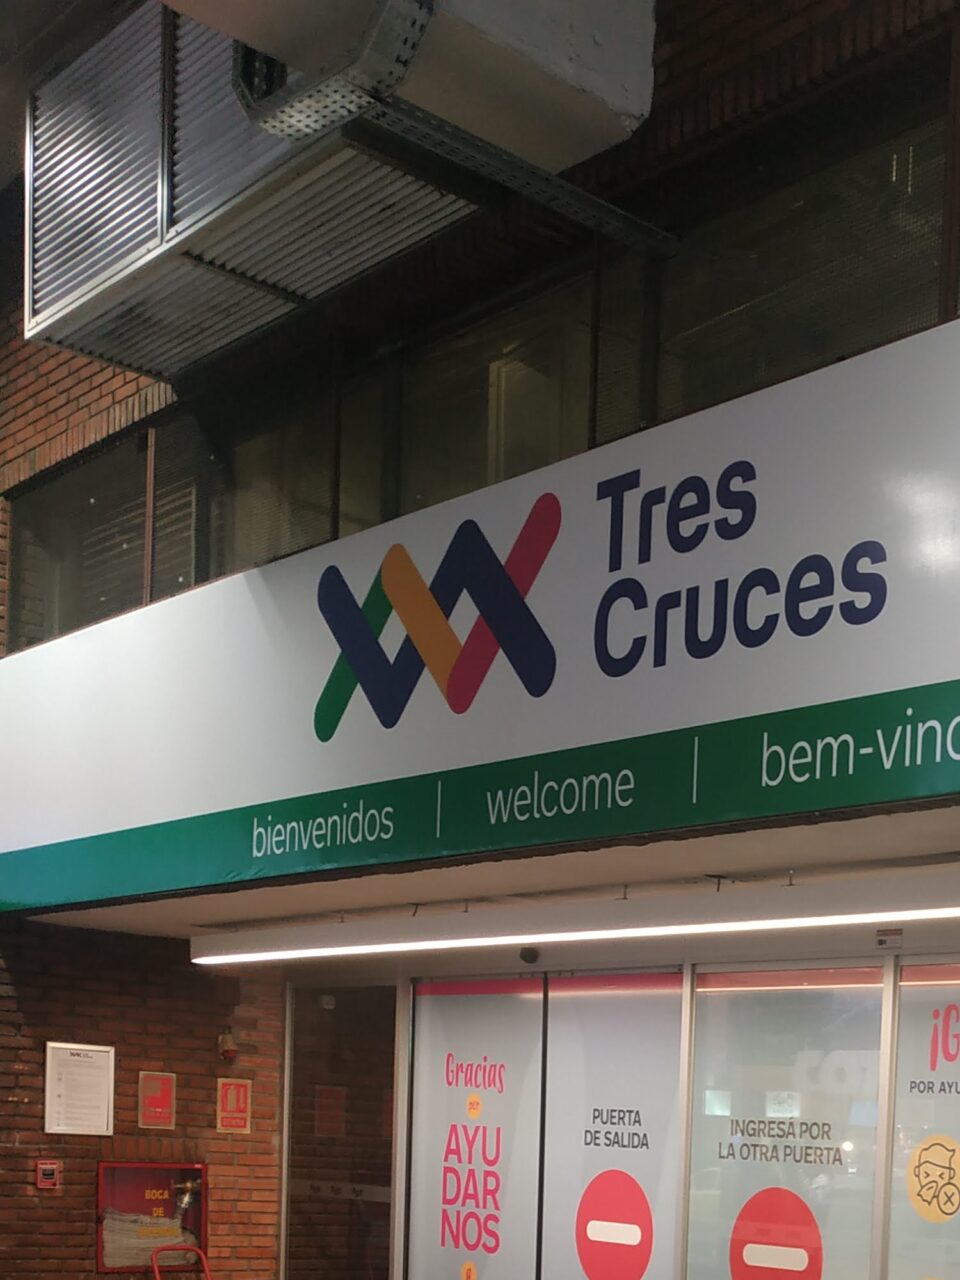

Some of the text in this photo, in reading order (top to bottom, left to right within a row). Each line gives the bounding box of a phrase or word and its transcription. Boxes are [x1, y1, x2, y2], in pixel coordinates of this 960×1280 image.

[596, 459, 757, 573] Tres
[594, 539, 889, 678] Cruces
[486, 762, 636, 825] welcome
[252, 801, 395, 858] bienvenidos
[445, 1053, 505, 1094] Gracias
[909, 1080, 934, 1095] POR
[592, 1108, 641, 1127] PUERTA
[730, 1117, 831, 1141] INGRESÁ POR
[443, 1123, 501, 1167] AYU
[584, 1130, 649, 1150] DE SALIDA
[718, 1142, 843, 1166] LA OTRA PUERTA
[144, 1189, 169, 1200] BOCA
[442, 1166, 501, 1211] DAR
[152, 1207, 165, 1217] DE
[440, 1208, 500, 1254] NOS
